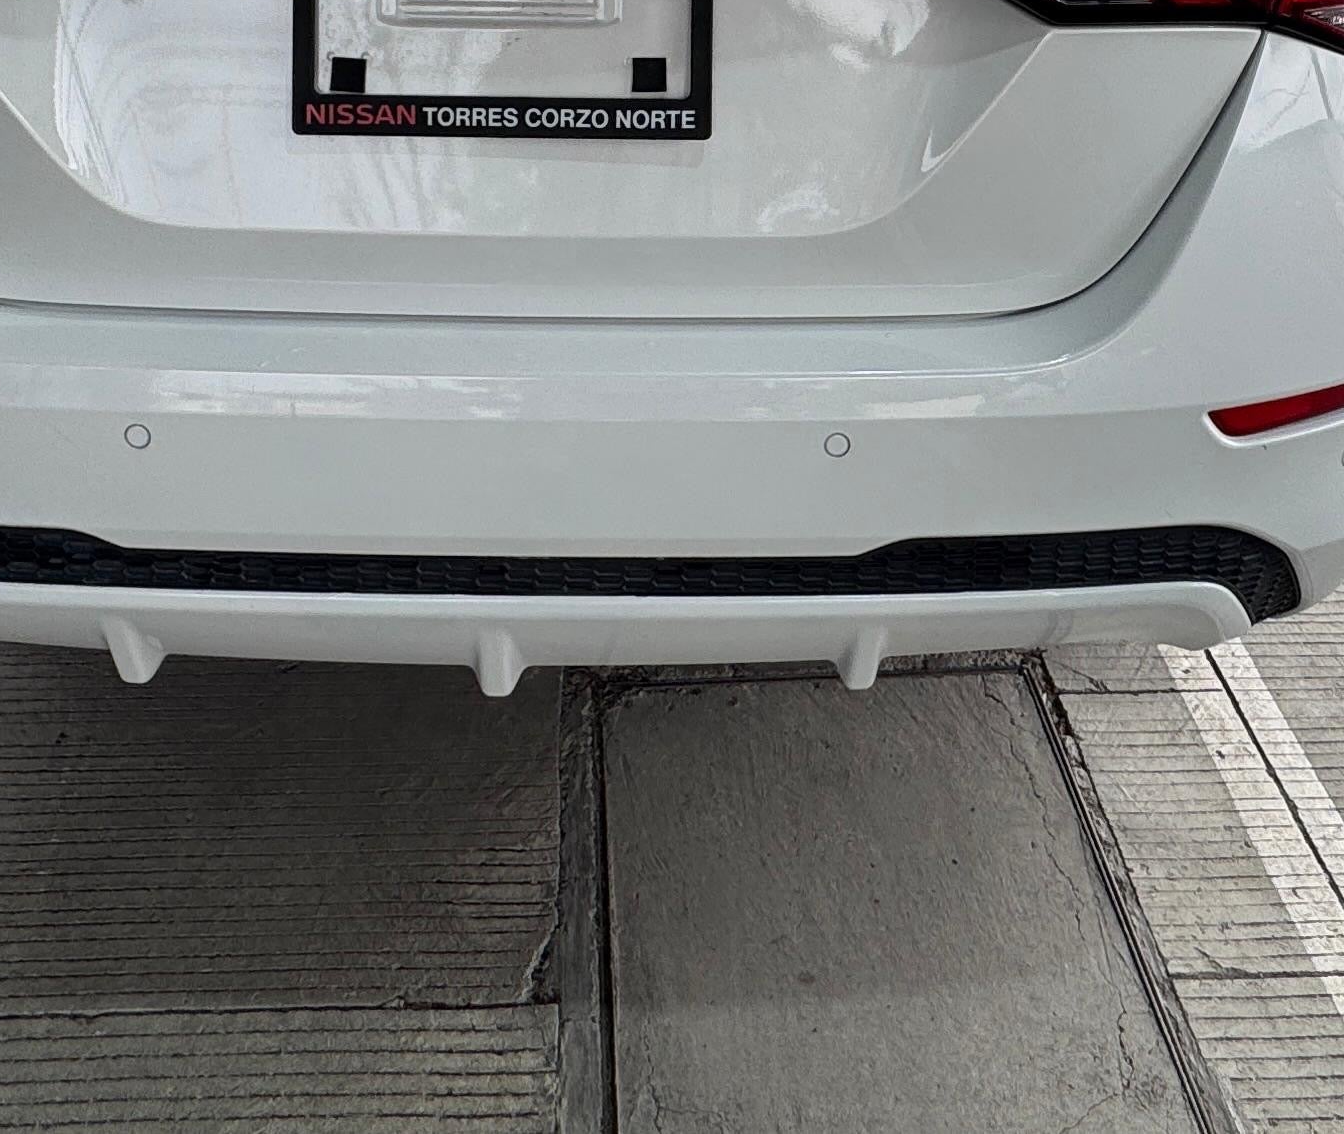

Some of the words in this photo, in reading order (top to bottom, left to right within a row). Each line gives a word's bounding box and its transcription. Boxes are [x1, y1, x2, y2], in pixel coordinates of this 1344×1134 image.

[305, 103, 416, 126] NISSAN
[422, 106, 519, 129] TORRES
[524, 107, 609, 130] CORZO
[615, 109, 696, 130] NORTE
